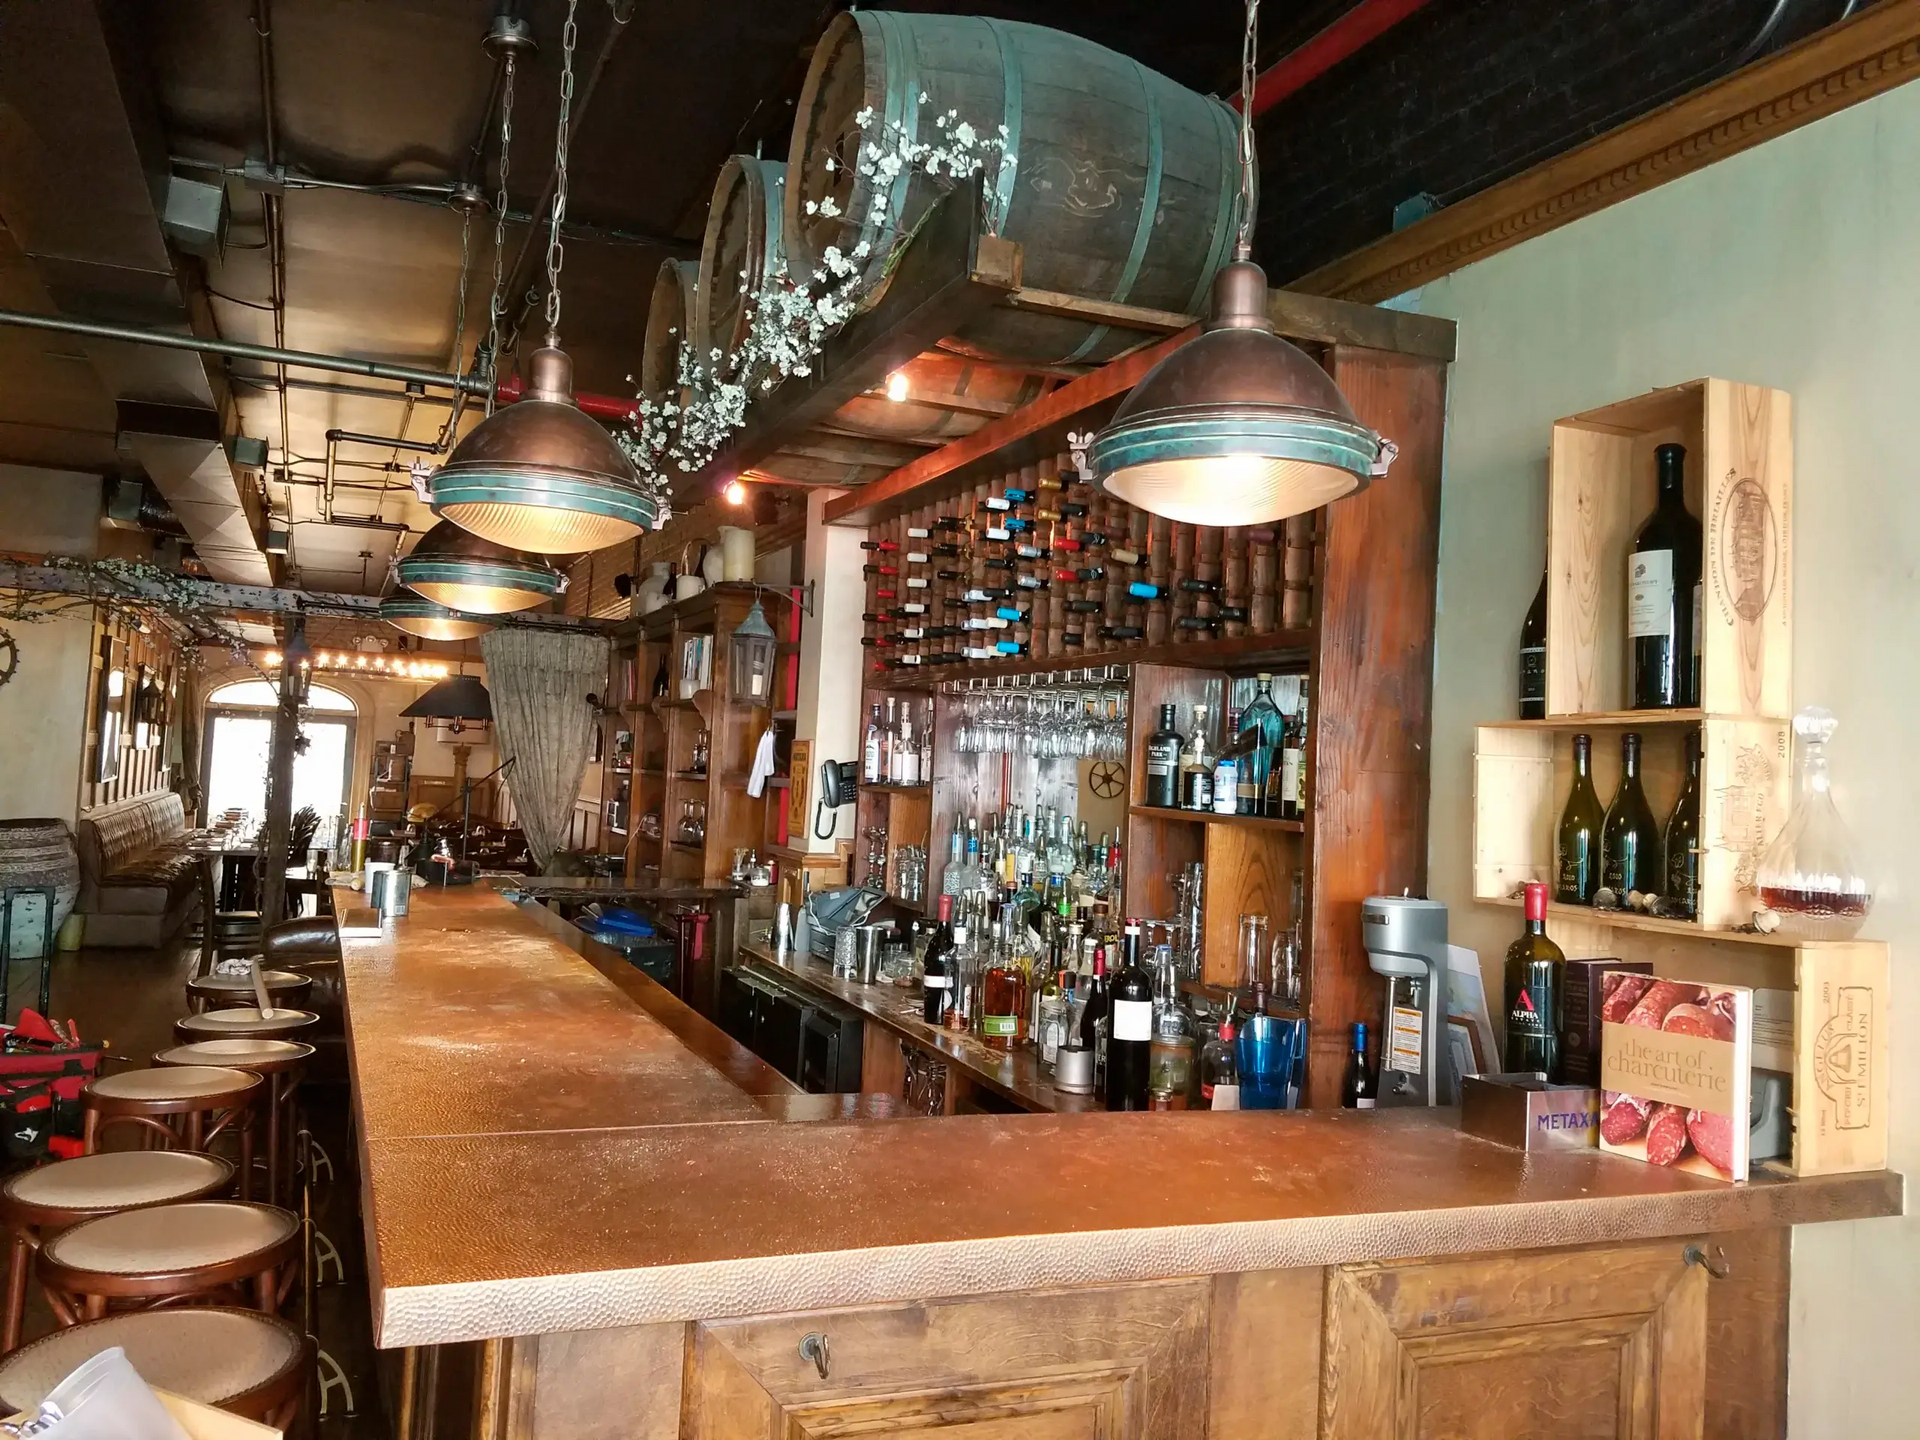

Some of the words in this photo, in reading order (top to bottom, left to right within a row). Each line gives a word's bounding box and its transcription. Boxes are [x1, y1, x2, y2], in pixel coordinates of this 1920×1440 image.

[1777, 731, 1786, 759] 2008
[1822, 981, 1831, 1004] 2003
[1511, 1009, 1539, 1020] ALPHA
[1625, 1039, 1652, 1060] the
[1655, 1049, 1680, 1065] art
[1685, 1050, 1707, 1070] of
[1607, 1050, 1728, 1092] charcuterie
